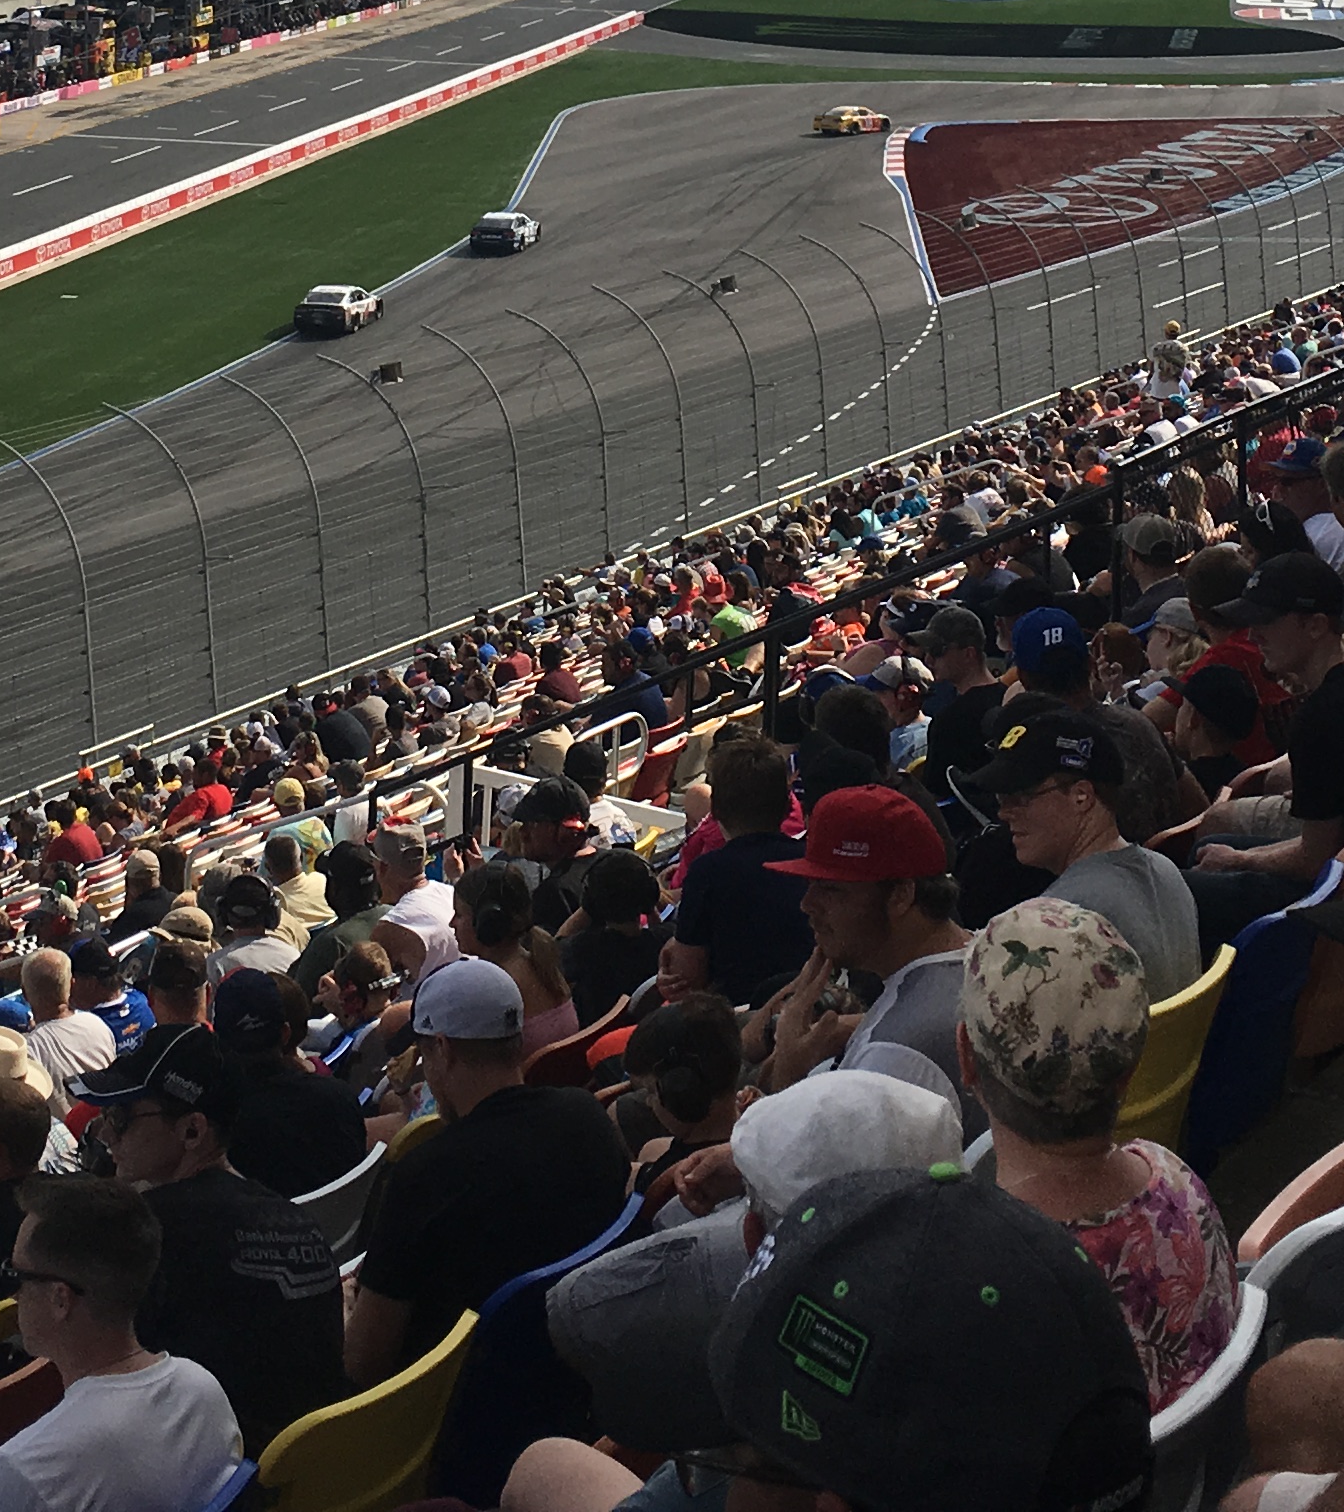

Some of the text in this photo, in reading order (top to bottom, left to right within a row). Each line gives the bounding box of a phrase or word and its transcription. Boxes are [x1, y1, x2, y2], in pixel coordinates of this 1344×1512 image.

[150, 200, 170, 218] TOYOTA
[100, 217, 123, 236] TOYOTA
[46, 237, 72, 258] TOYOTA
[1042, 626, 1064, 647] 18
[288, 1246, 328, 1264] 400
